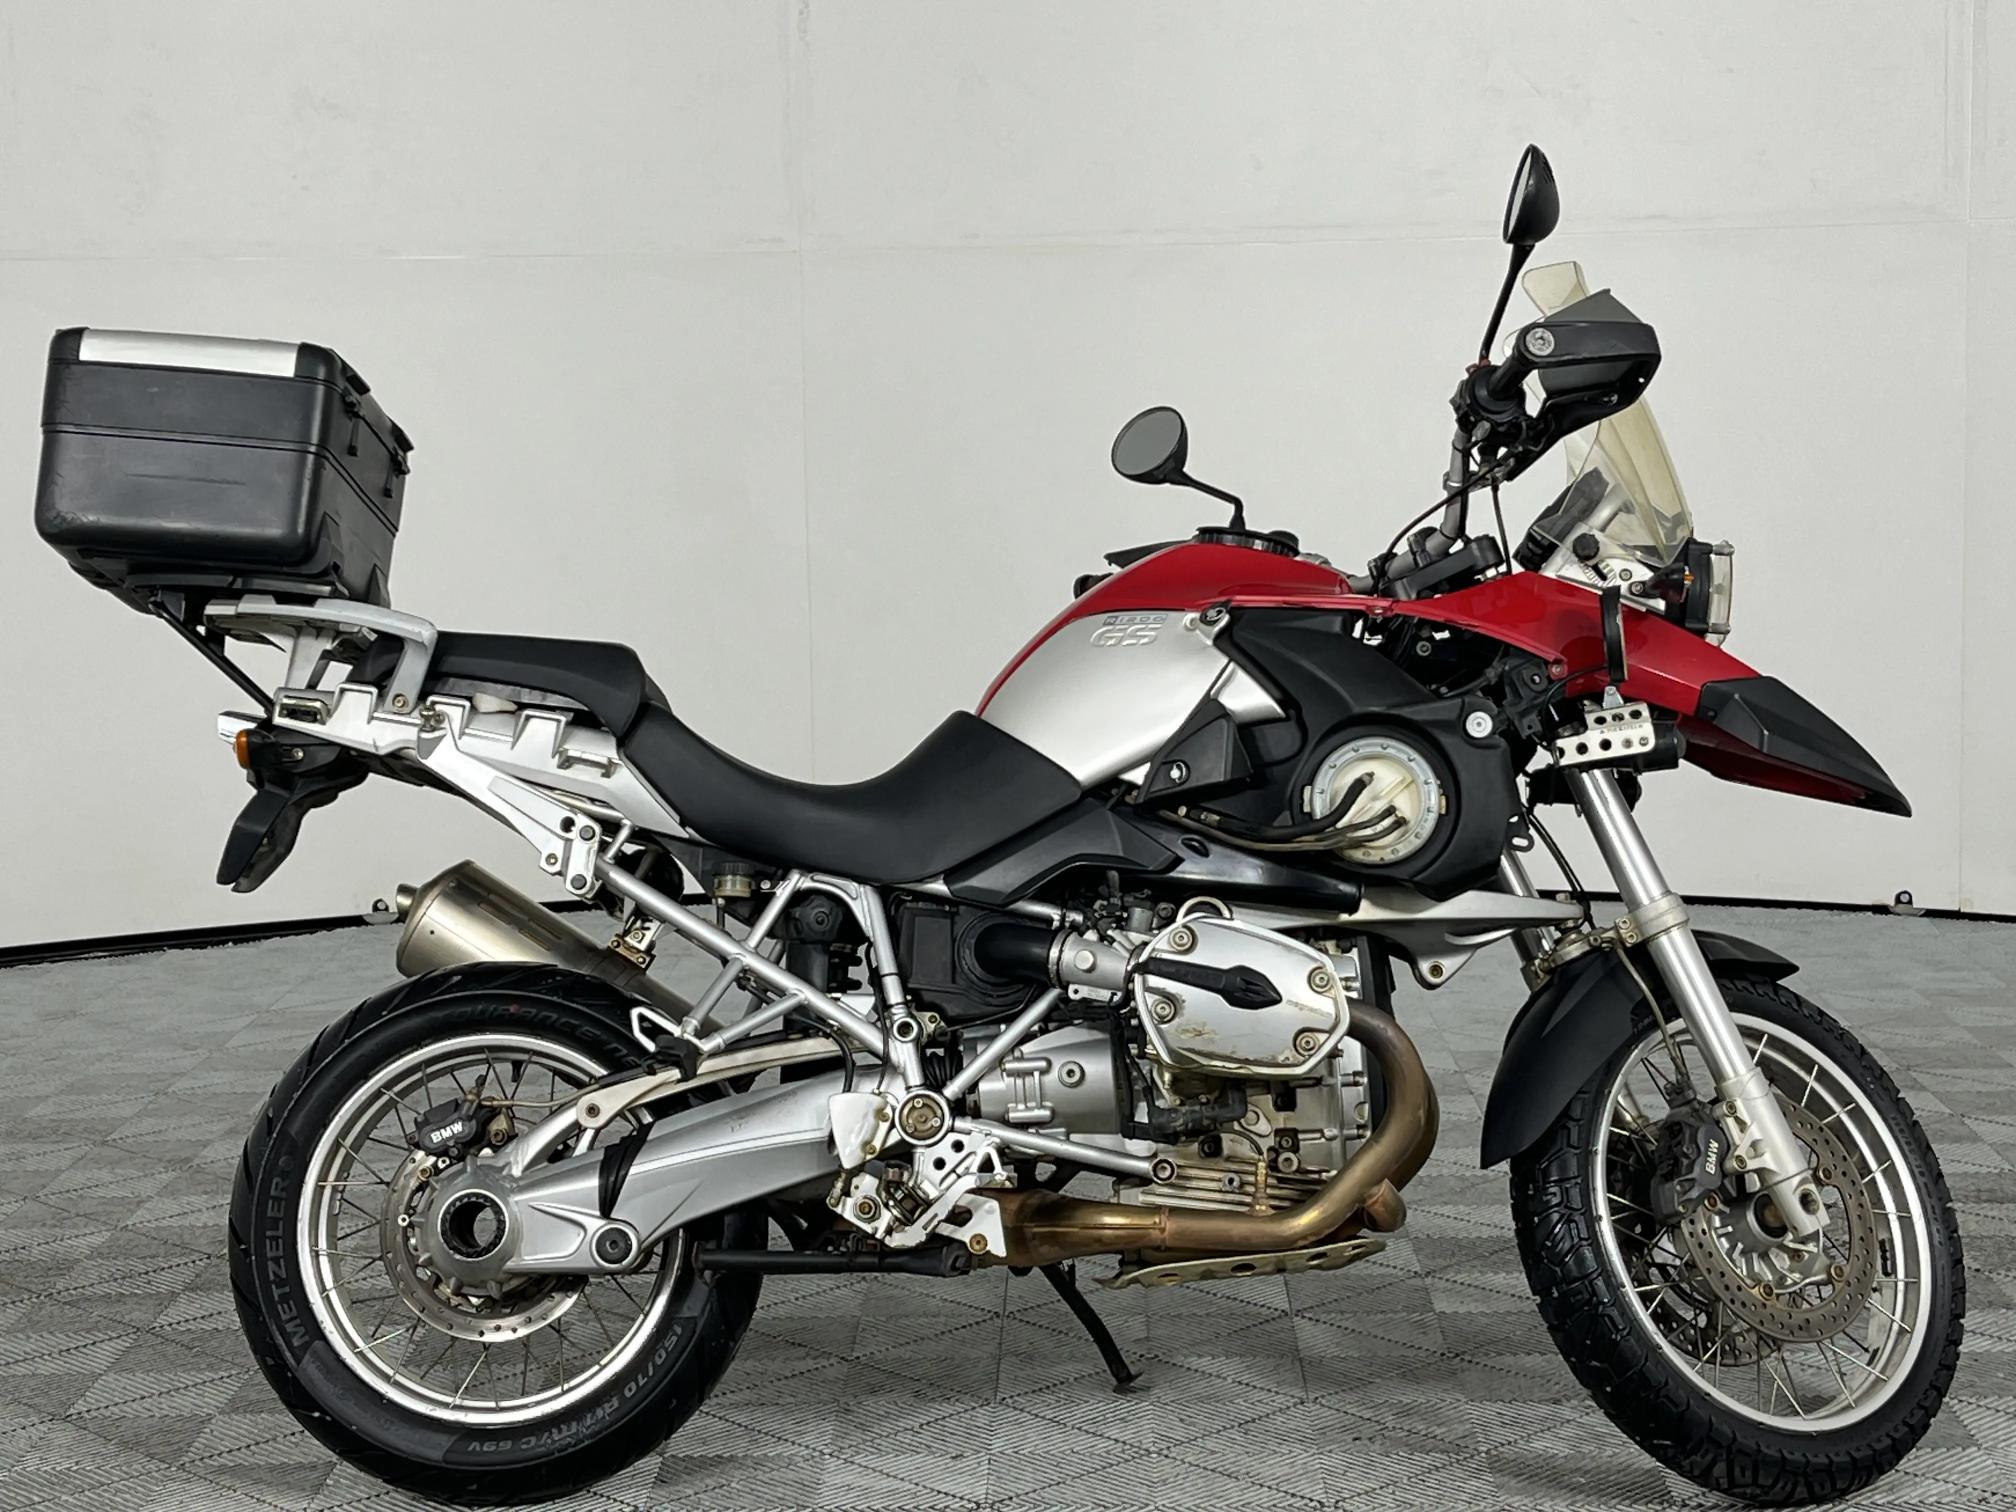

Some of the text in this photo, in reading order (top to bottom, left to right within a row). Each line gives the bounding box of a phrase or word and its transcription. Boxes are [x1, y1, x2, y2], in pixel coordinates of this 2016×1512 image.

[1090, 624, 1162, 647] GS
[430, 1120, 463, 1144] BMW
[1705, 1138, 1719, 1175] BMW
[265, 1176, 311, 1348] METZELER
[622, 1322, 683, 1400] 150/70
[466, 1438, 513, 1453] 69V
